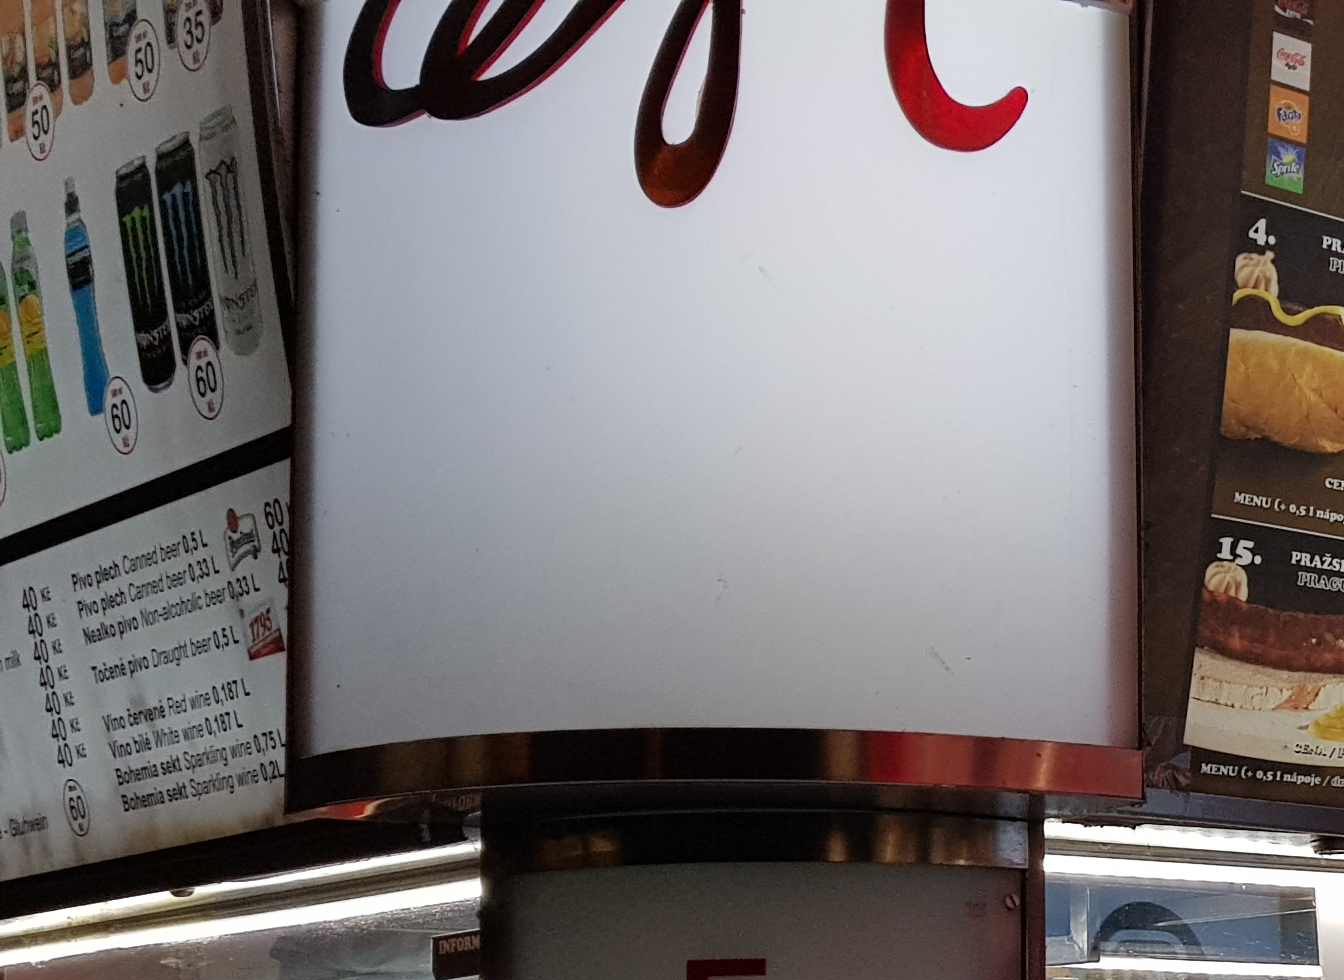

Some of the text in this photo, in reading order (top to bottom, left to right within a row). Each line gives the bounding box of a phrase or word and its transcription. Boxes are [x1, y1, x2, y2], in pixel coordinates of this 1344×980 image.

[183, 12, 204, 48] 35
[134, 47, 155, 80] 50
[31, 109, 50, 141] 50
[1277, 107, 1302, 122] Fanta
[1271, 161, 1300, 175] Sprite
[1248, 218, 1276, 245] 4.
[195, 360, 217, 396] 60
[110, 400, 132, 433] 60
[71, 530, 208, 592] Pivo plech Canned beer 0,5 L
[1215, 536, 1262, 566] 15.
[22, 587, 37, 612] 40
[91, 625, 240, 685] Točené pivo Draught beer 0,5 L
[121, 788, 165, 813] Bohemia
[166, 781, 189, 803] sekt
[190, 771, 235, 803] Sparkling
[236, 766, 259, 787] wine
[69, 797, 85, 821] 60
